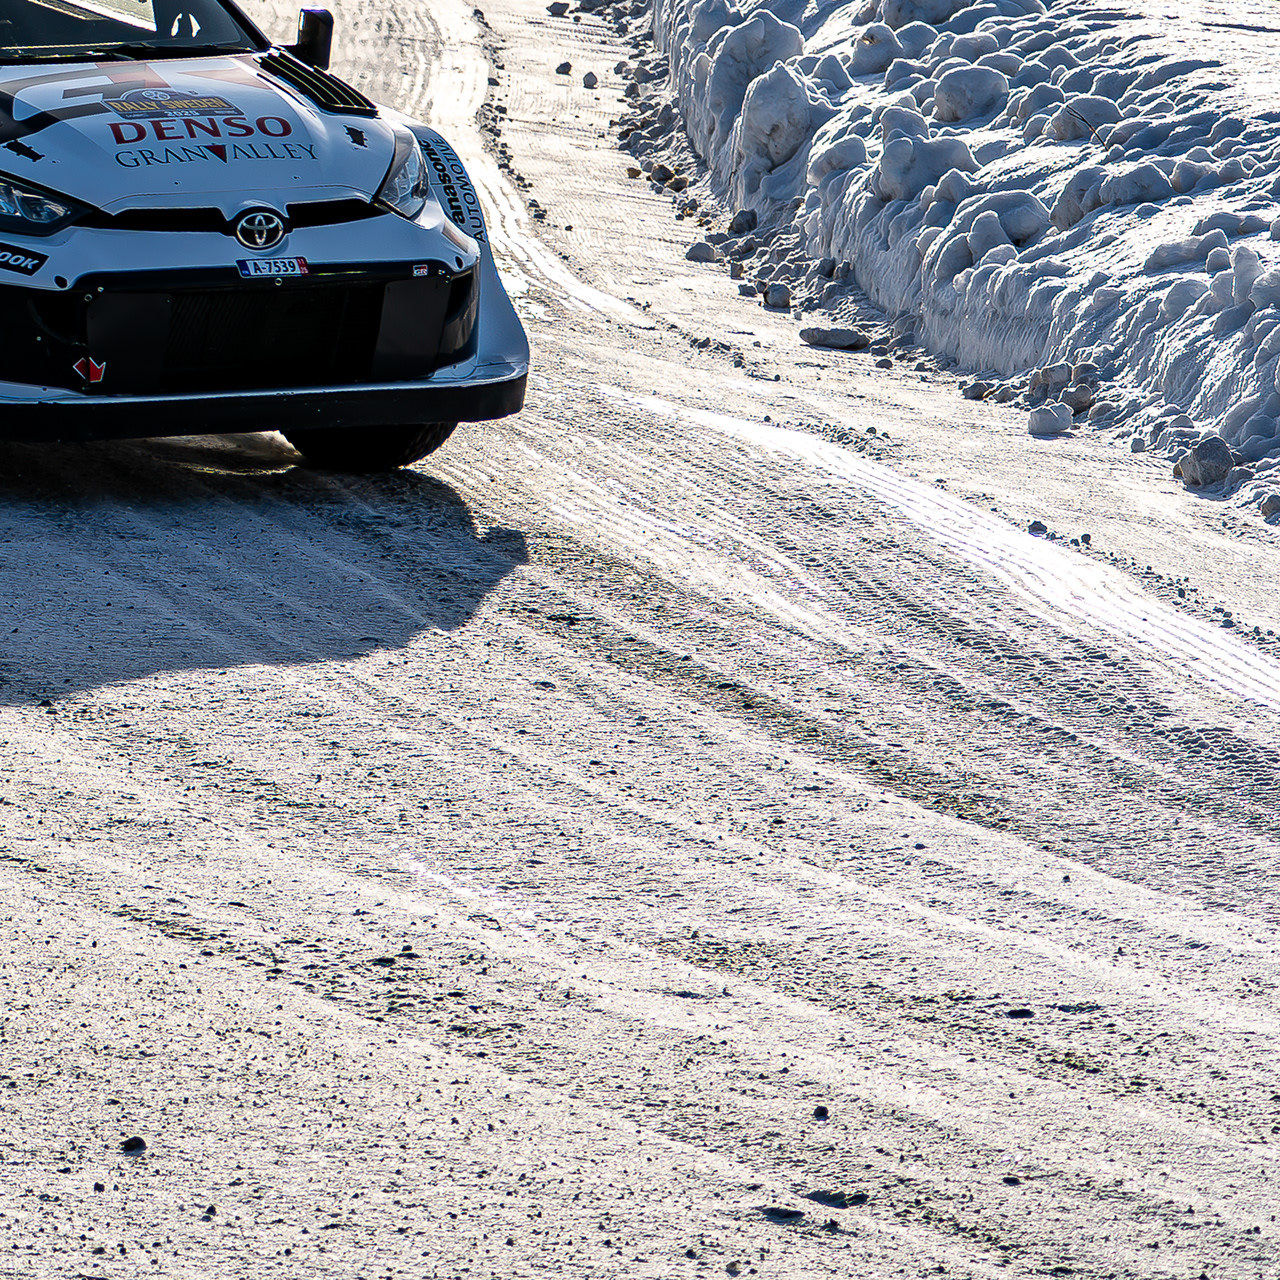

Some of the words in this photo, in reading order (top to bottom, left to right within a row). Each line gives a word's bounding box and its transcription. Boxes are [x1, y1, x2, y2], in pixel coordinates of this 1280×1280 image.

[108, 100, 160, 112] RALLY
[161, 97, 230, 110] SWEDEN
[107, 116, 293, 145] DENSO
[418, 139, 466, 225] anasonic
[430, 138, 487, 244] AUTOMOTIVE
[252, 261, 296, 274] A-7539
